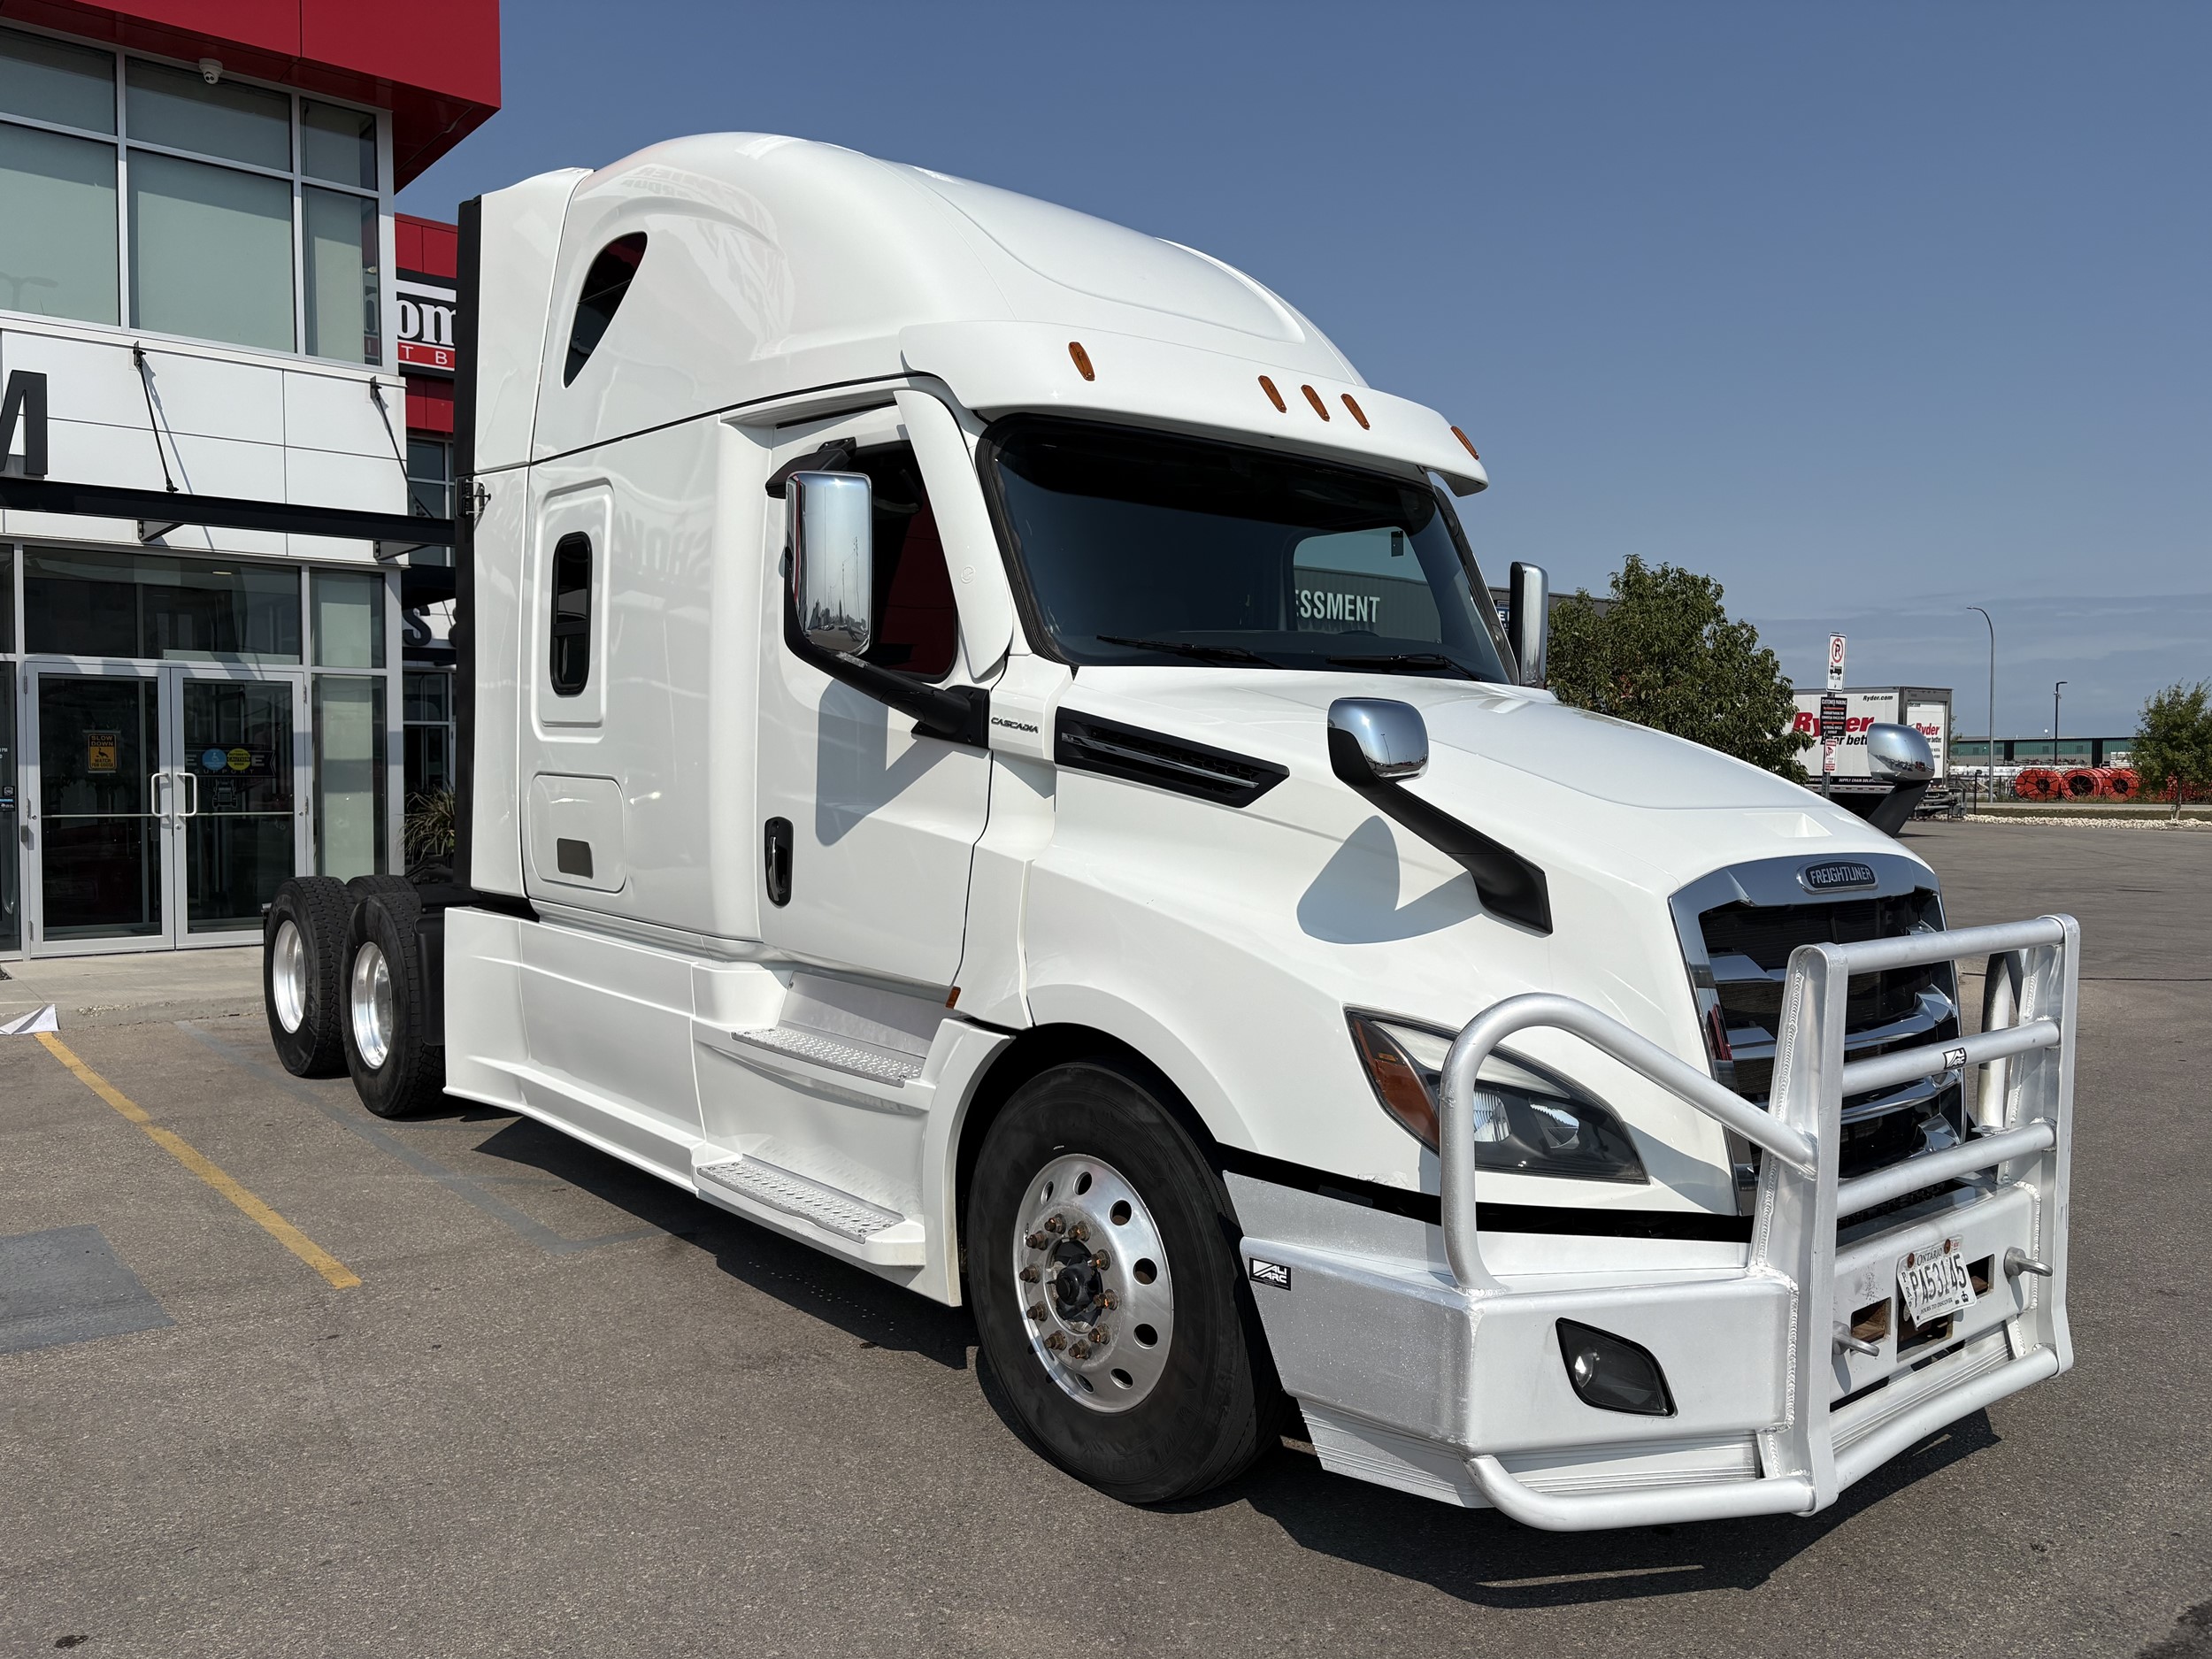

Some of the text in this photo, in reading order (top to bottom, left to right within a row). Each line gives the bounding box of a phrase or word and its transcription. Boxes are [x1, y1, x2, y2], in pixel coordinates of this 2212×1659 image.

[991, 717, 1039, 733] CASCADIA
[1793, 712, 1875, 737] Ryer
[1809, 866, 1873, 885] FREIGHTLINER
[1916, 1248, 1943, 1266] ONTARIO
[1909, 1253, 1967, 1309] PA53145
